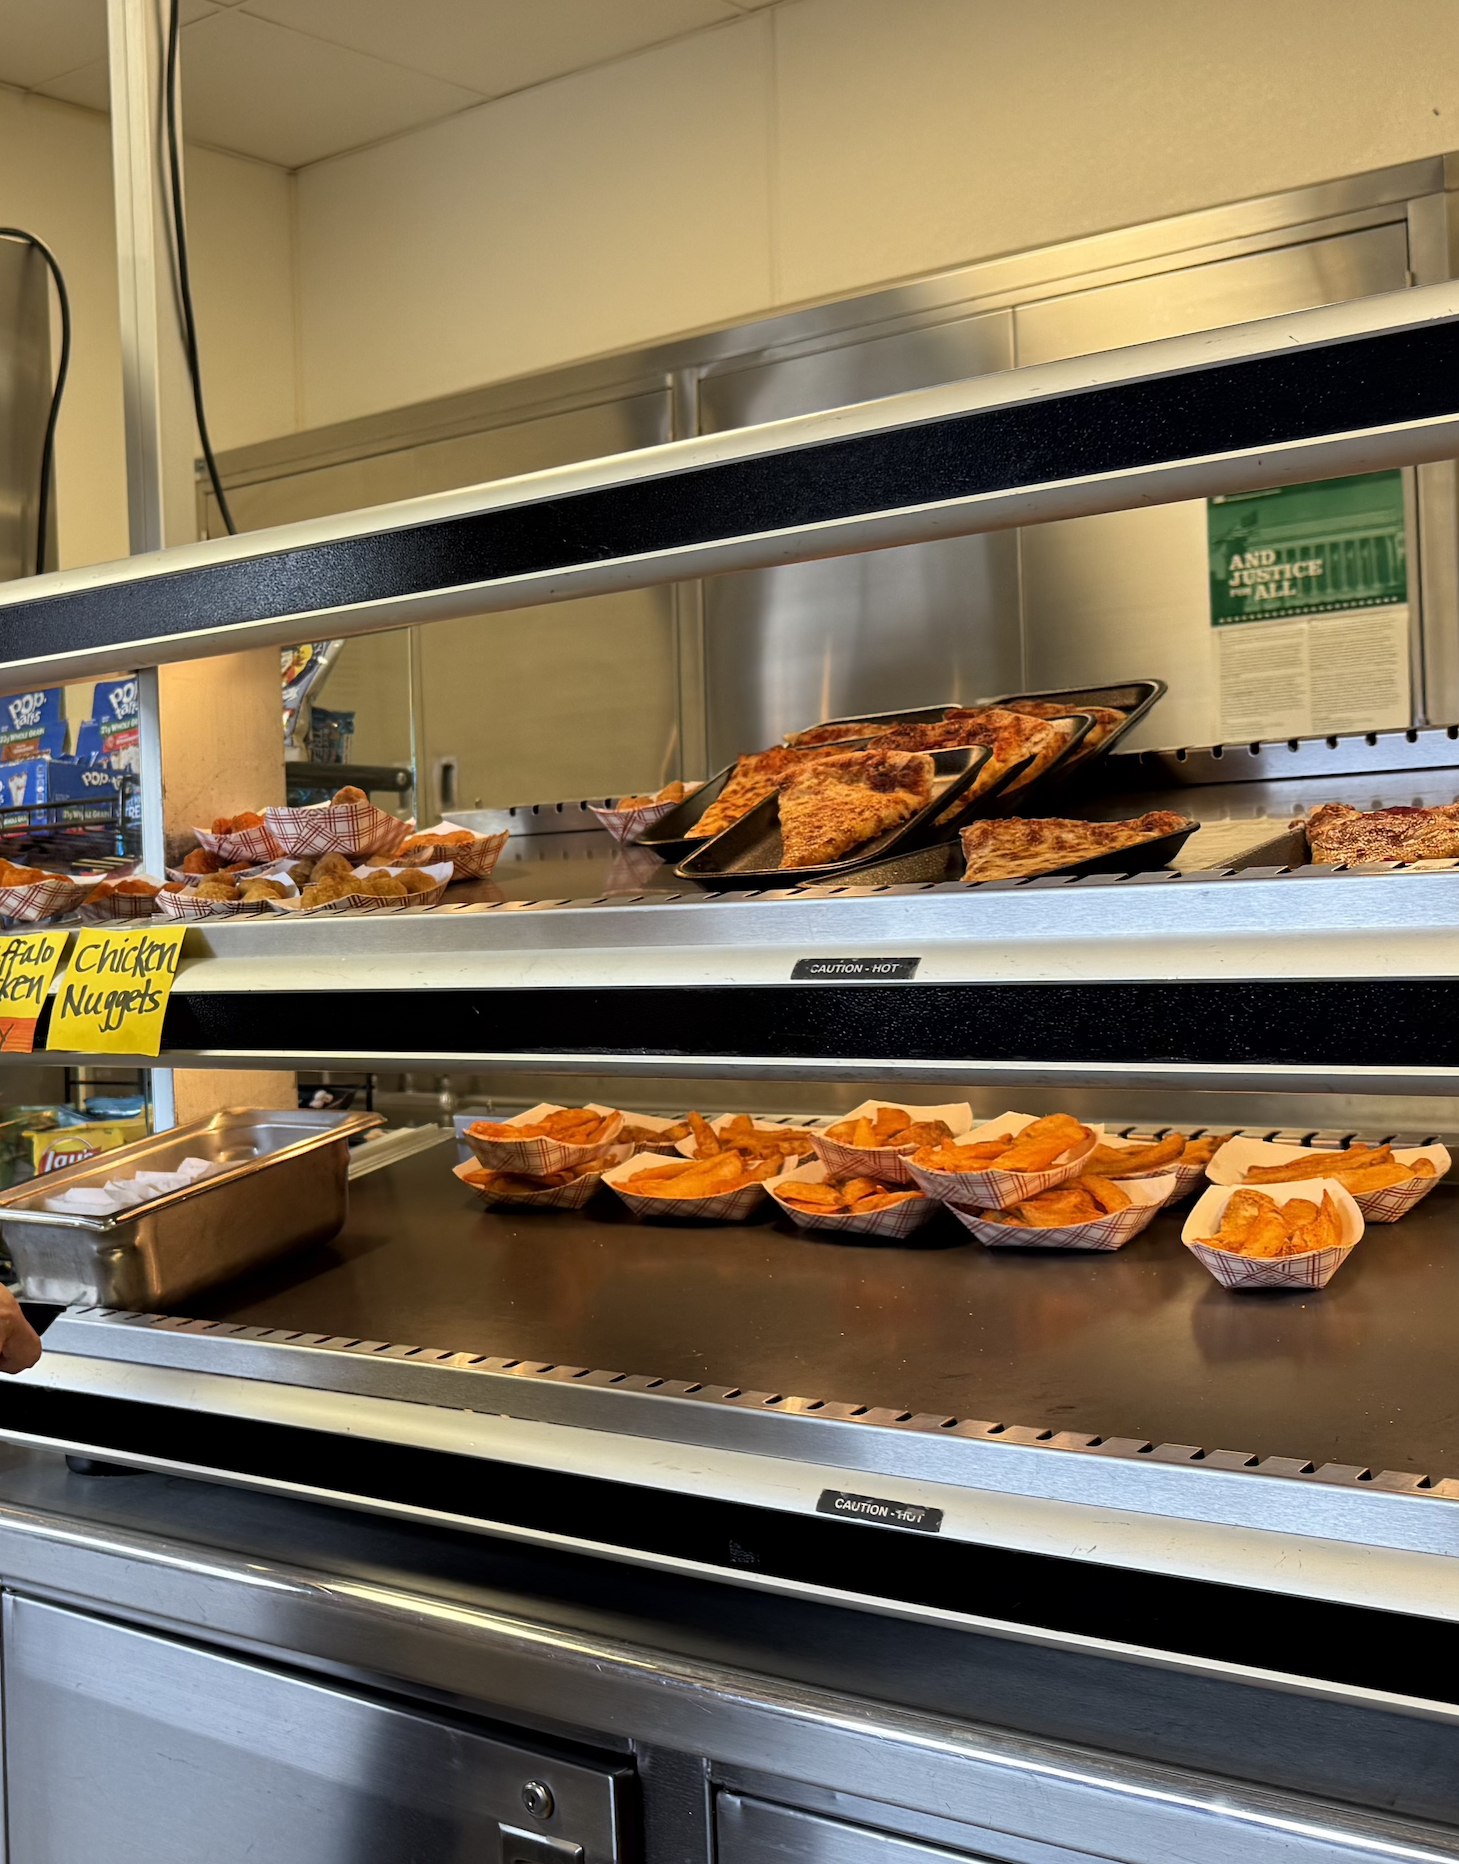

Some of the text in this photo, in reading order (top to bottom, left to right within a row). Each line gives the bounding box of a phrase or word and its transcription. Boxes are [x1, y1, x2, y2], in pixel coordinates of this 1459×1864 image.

[1229, 549, 1277, 571] AND
[1228, 559, 1324, 588] JUSTICE
[1254, 580, 1297, 601] ALL
[75, 936, 178, 978] Chicken
[810, 963, 863, 974] CAUTION
[871, 963, 900, 973] HOT
[60, 978, 163, 1033] Nuggets
[834, 1498, 888, 1518] CAUTION
